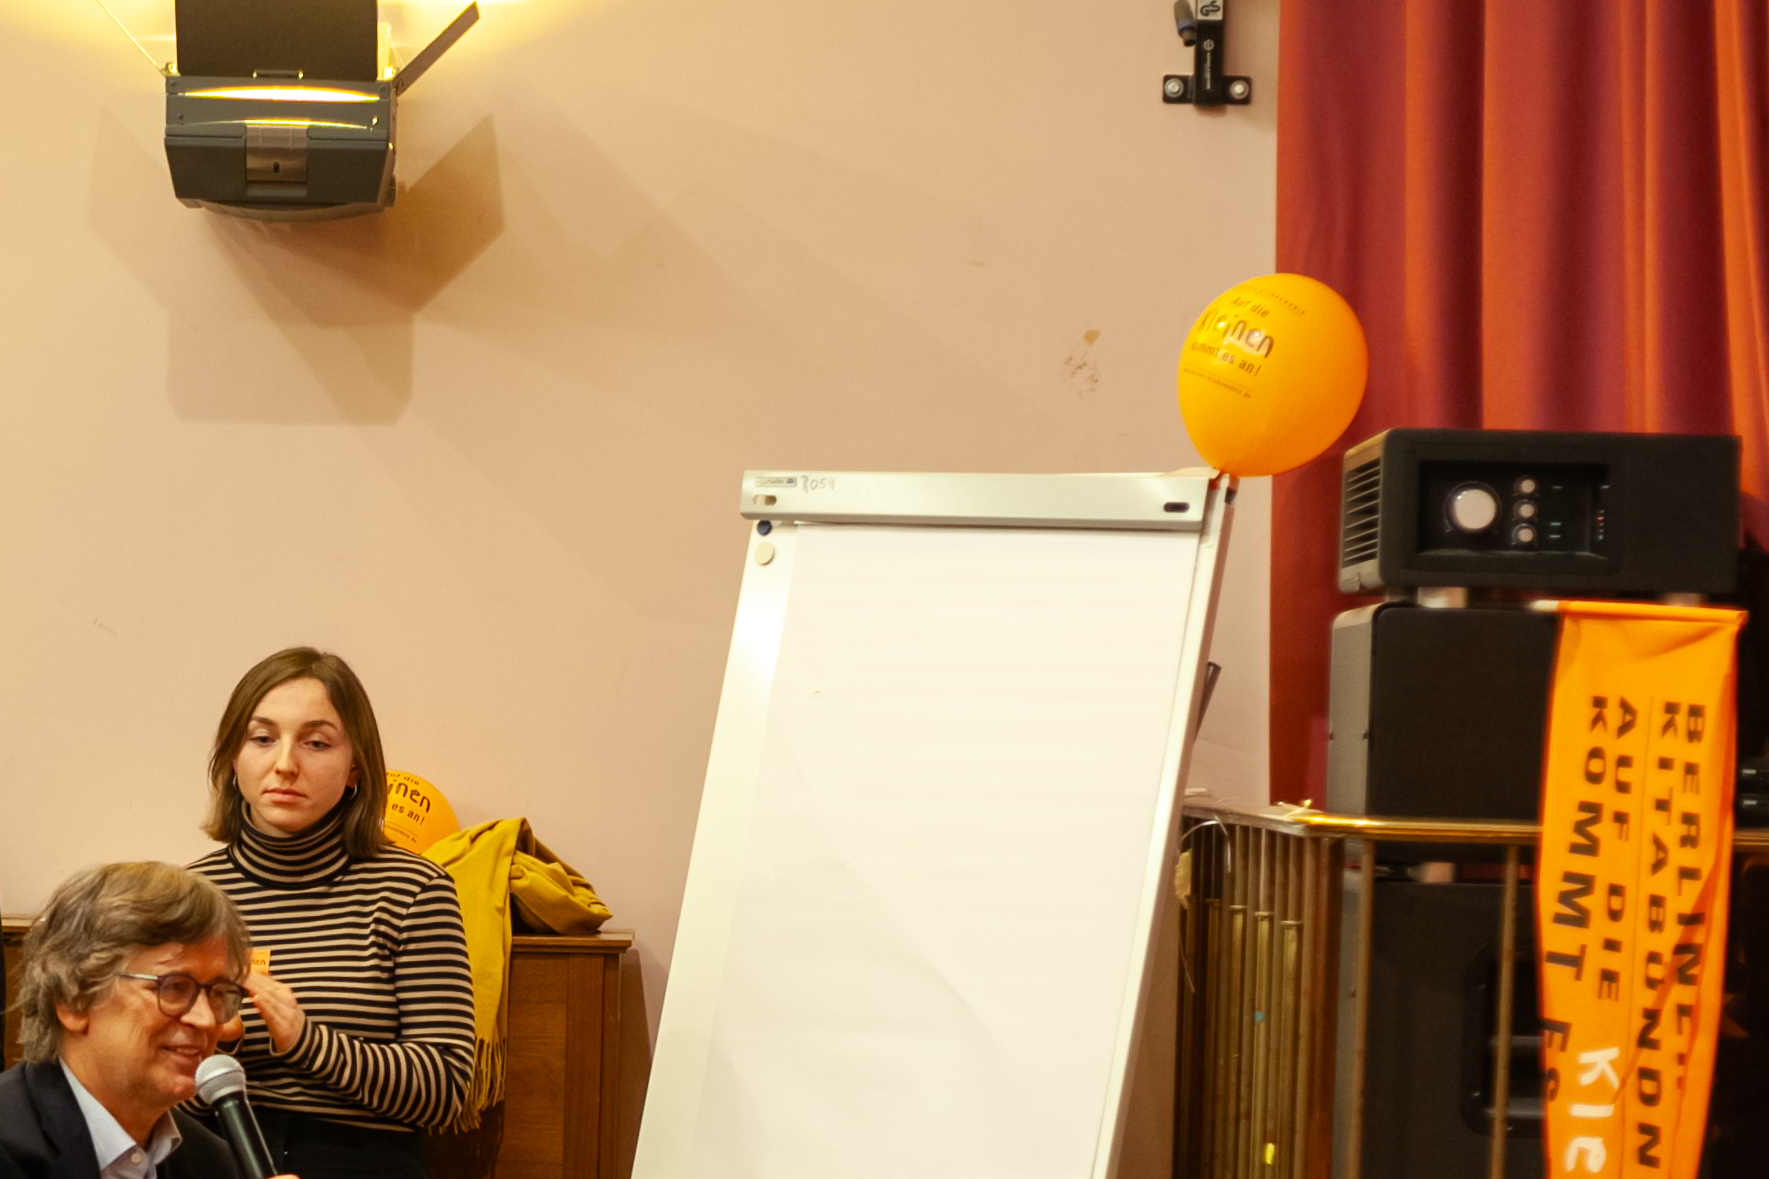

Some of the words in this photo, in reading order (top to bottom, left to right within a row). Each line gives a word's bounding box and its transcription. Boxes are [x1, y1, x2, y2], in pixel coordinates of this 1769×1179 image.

[1197, 307, 1274, 358] Kleinen
[1230, 296, 1251, 308] Auf
[1250, 304, 1271, 318] die
[1221, 352, 1236, 365] es
[1238, 359, 1263, 377] an!
[1612, 695, 1639, 842] AUF
[391, 803, 405, 814] es
[407, 810, 426, 826] an!
[1544, 695, 1609, 982] KOMMT
[1598, 882, 1627, 1002] DIE
